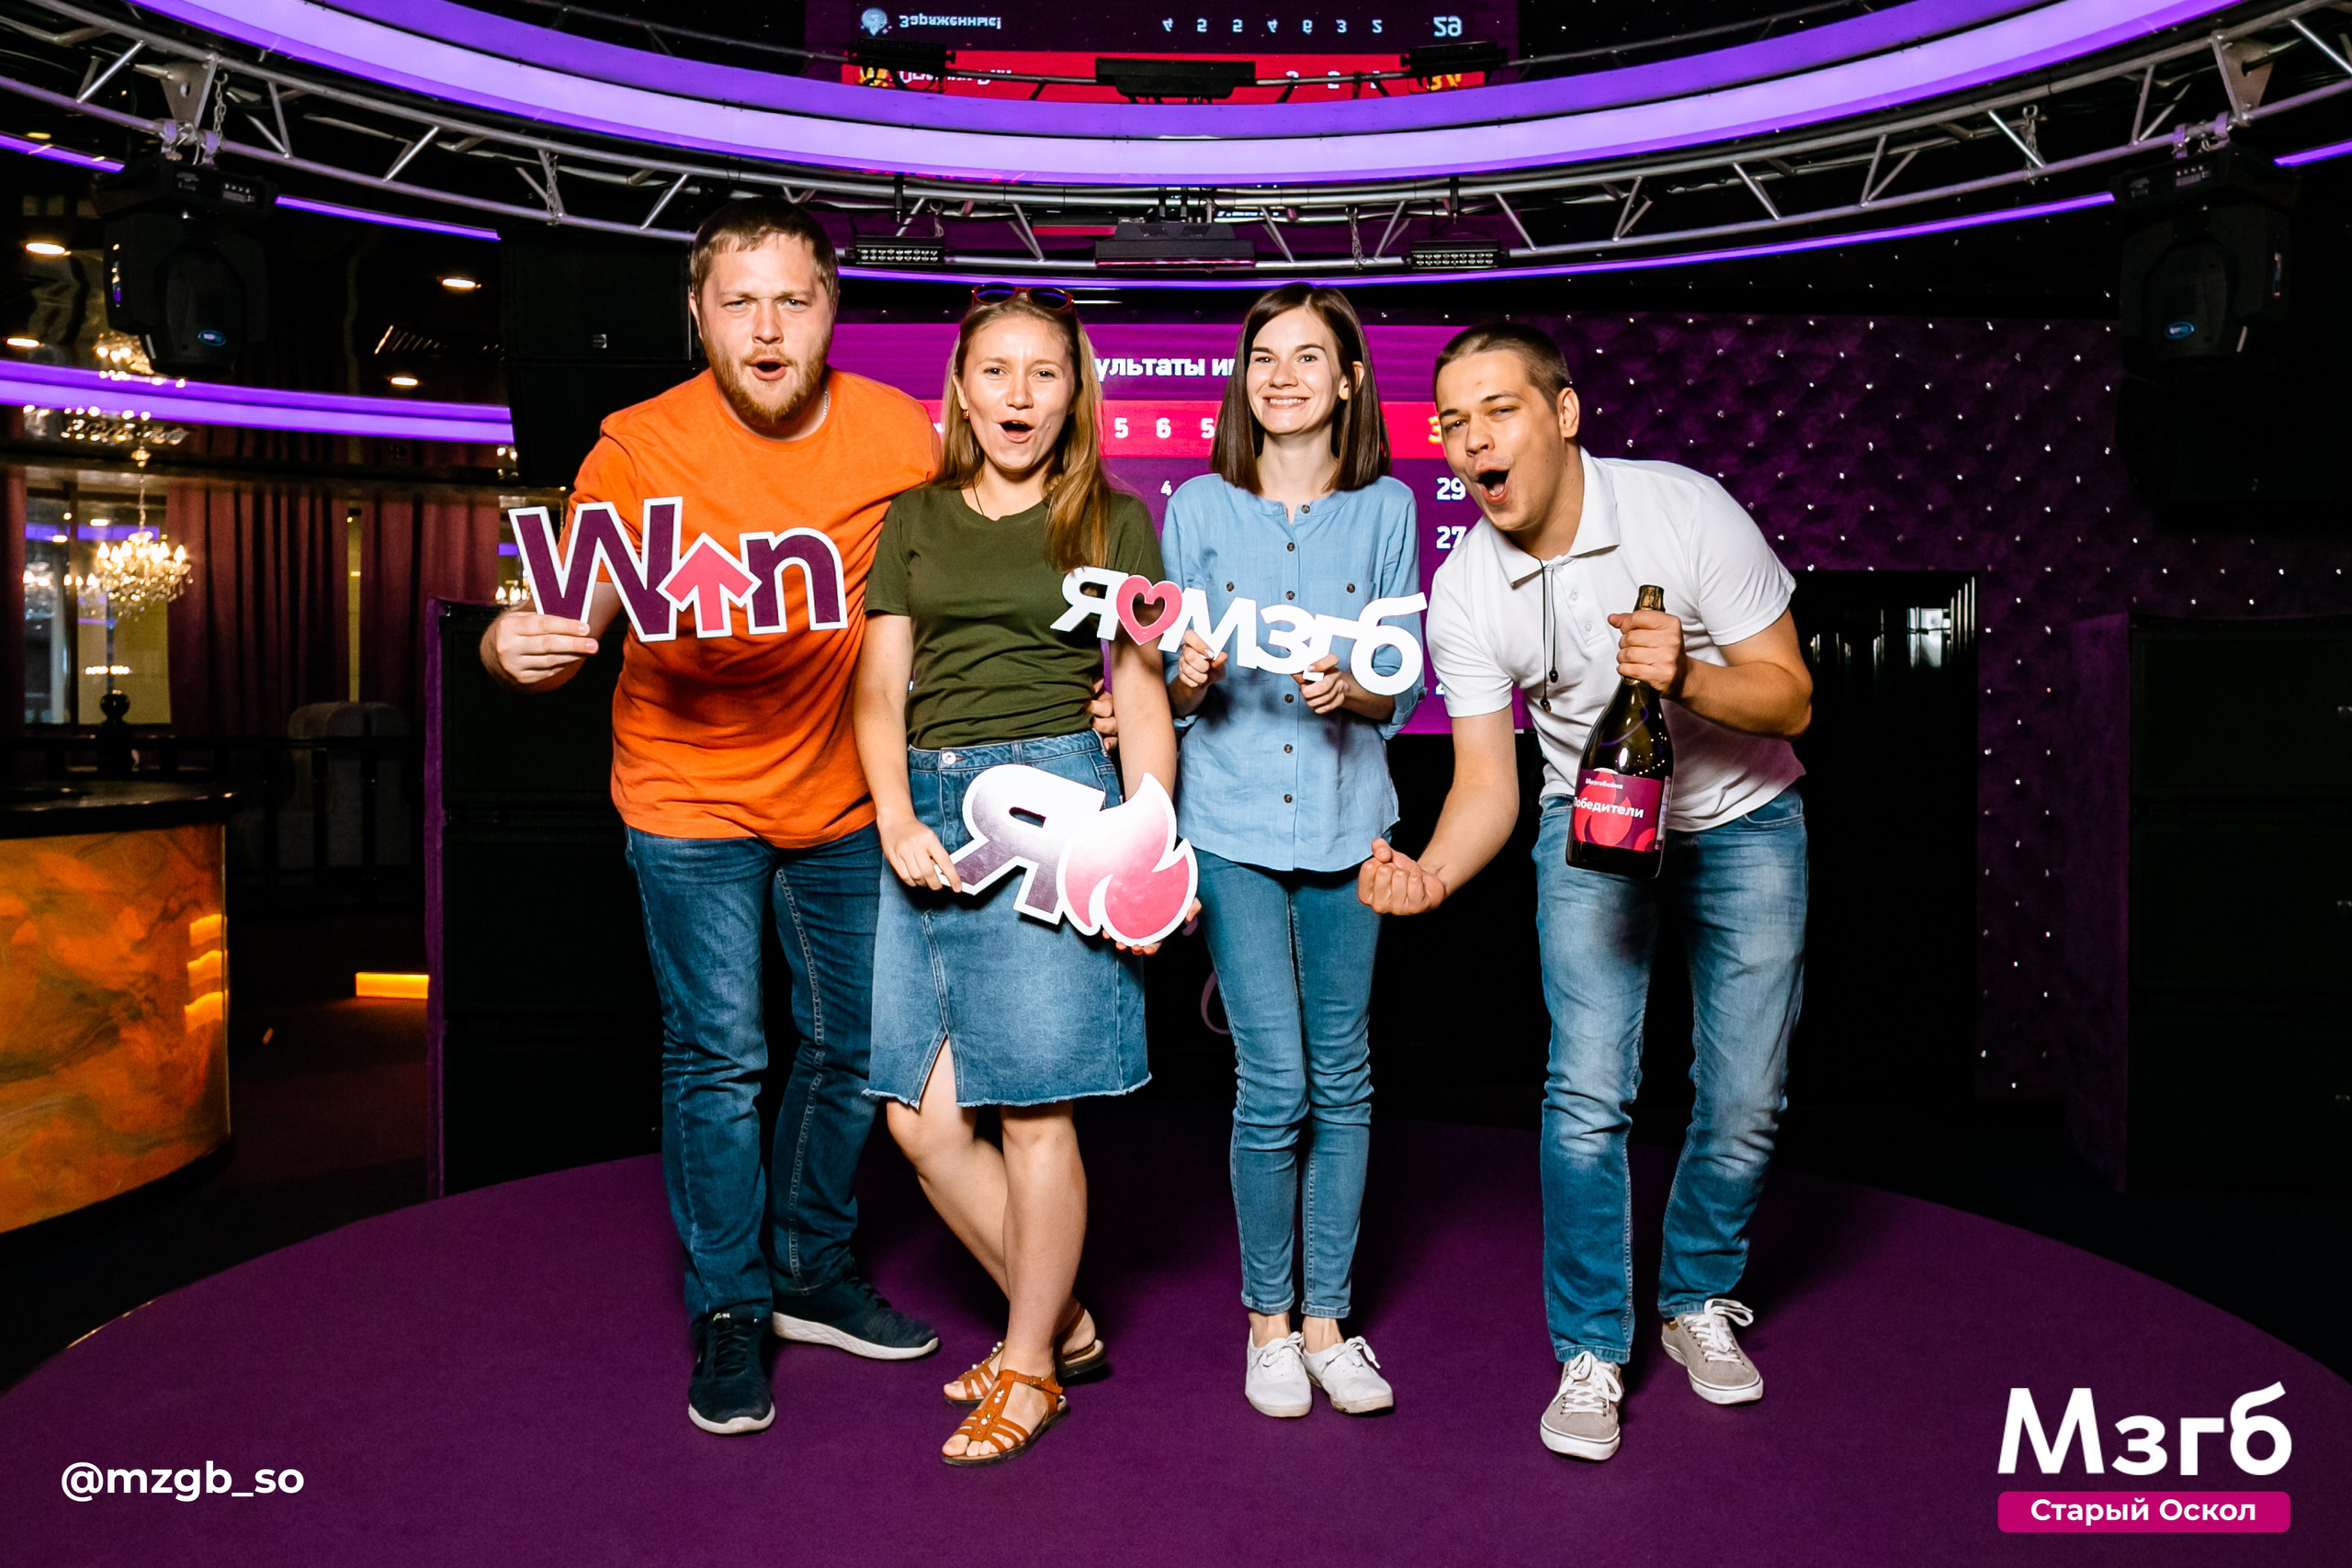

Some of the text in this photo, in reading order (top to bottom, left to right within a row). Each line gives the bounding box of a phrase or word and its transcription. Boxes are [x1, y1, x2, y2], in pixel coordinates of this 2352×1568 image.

[1114, 417, 1129, 438] 5
[1156, 417, 1171, 438] 6
[1201, 417, 1216, 438] 5
[1160, 477, 1466, 501] 4 29
[1436, 525, 1467, 549] 27
[933, 763, 1106, 925] Я
